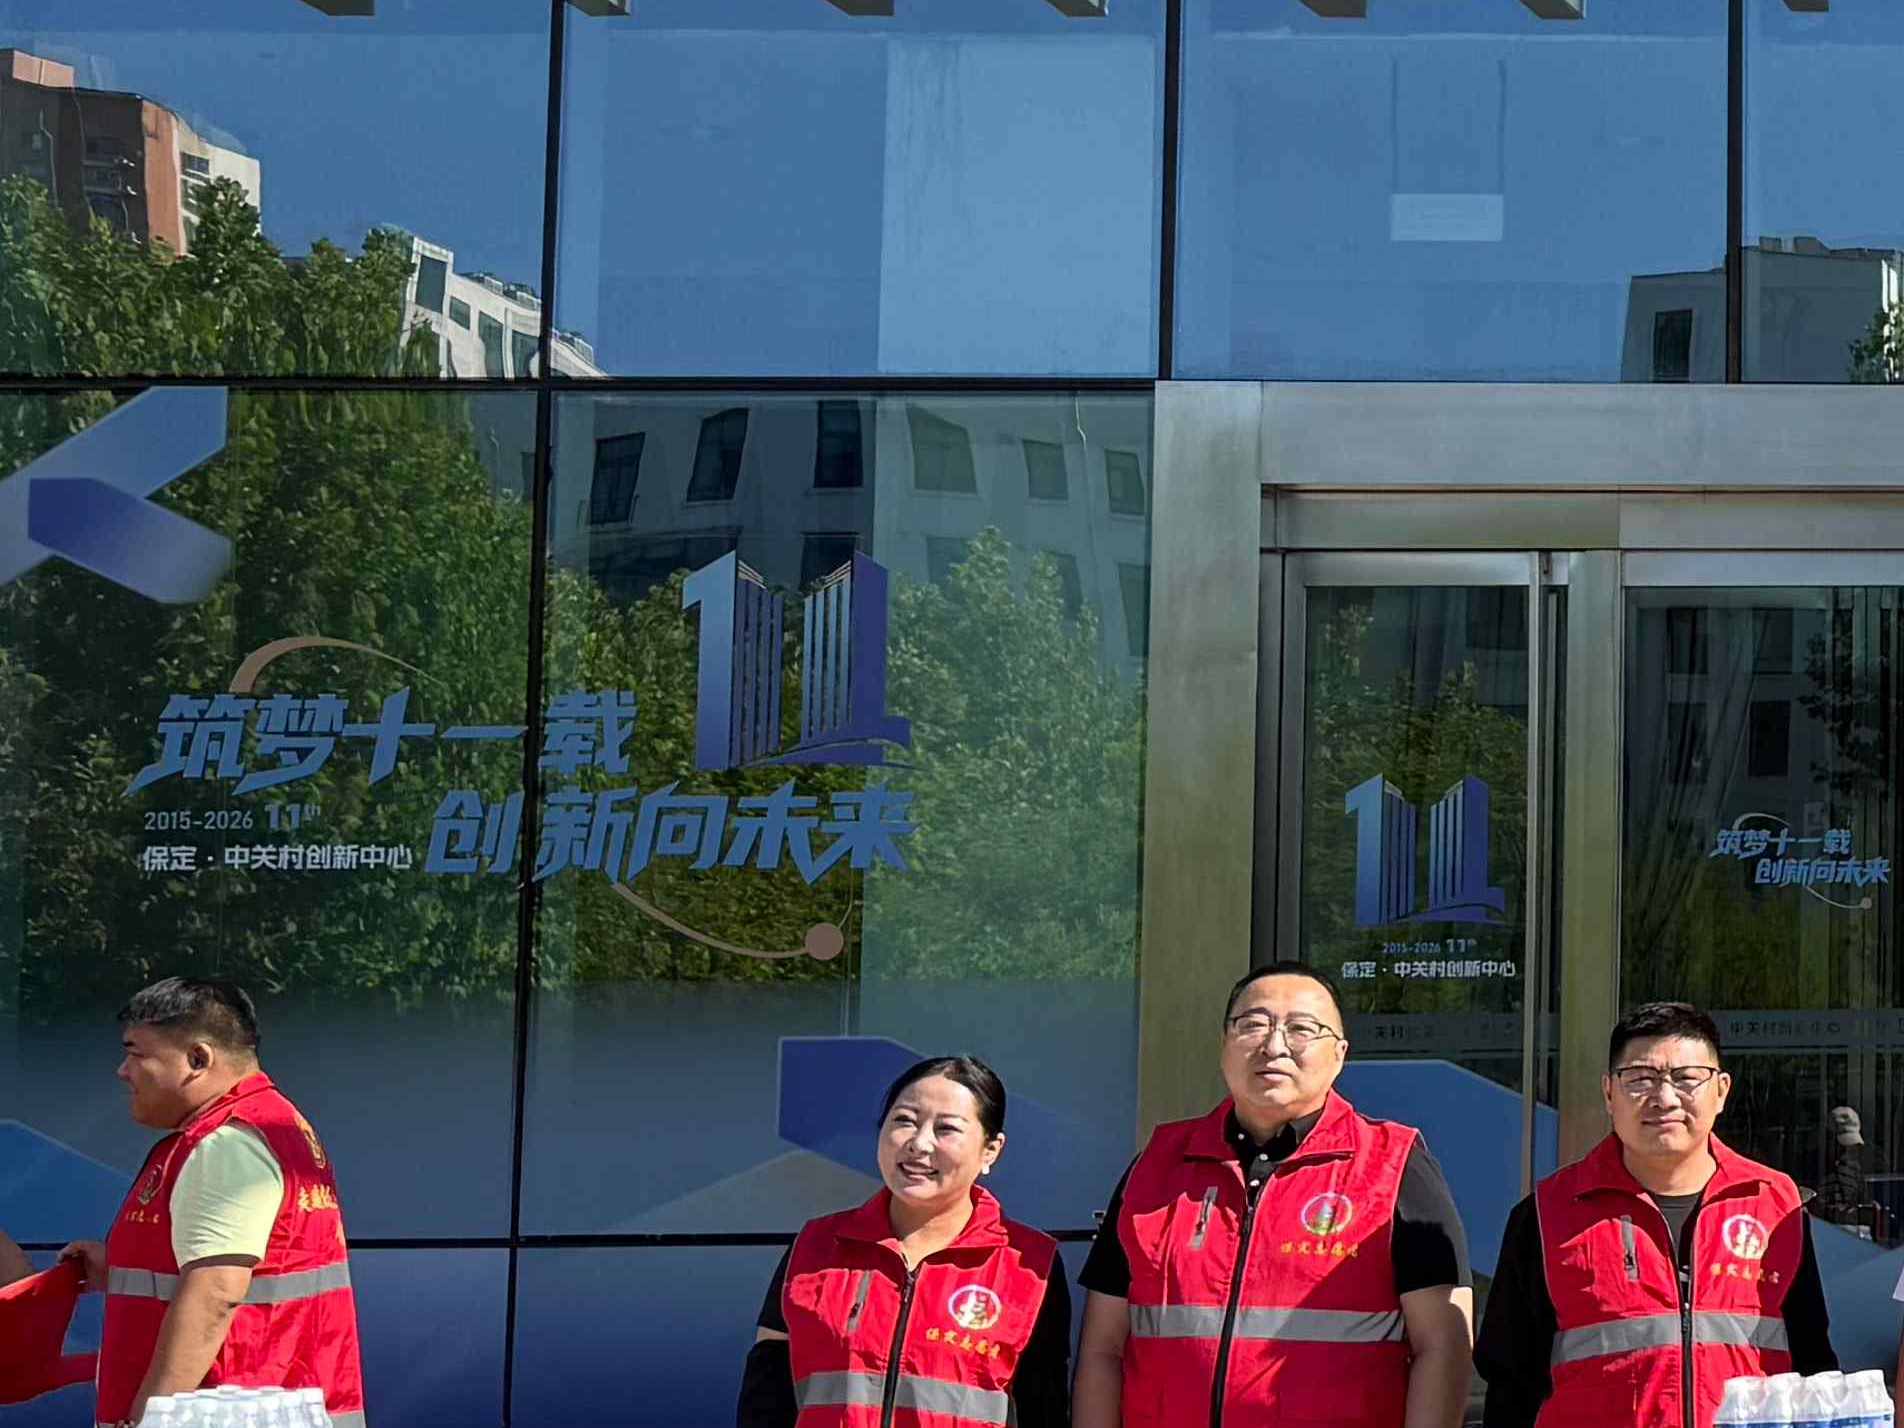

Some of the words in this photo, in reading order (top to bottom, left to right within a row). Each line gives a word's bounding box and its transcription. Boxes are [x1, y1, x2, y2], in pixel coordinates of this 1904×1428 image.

[121, 687, 637, 796] 筑梦十一载
[144, 810, 253, 830] 2015-2026
[265, 803, 321, 829] 11th
[424, 779, 916, 884] 创新向未来
